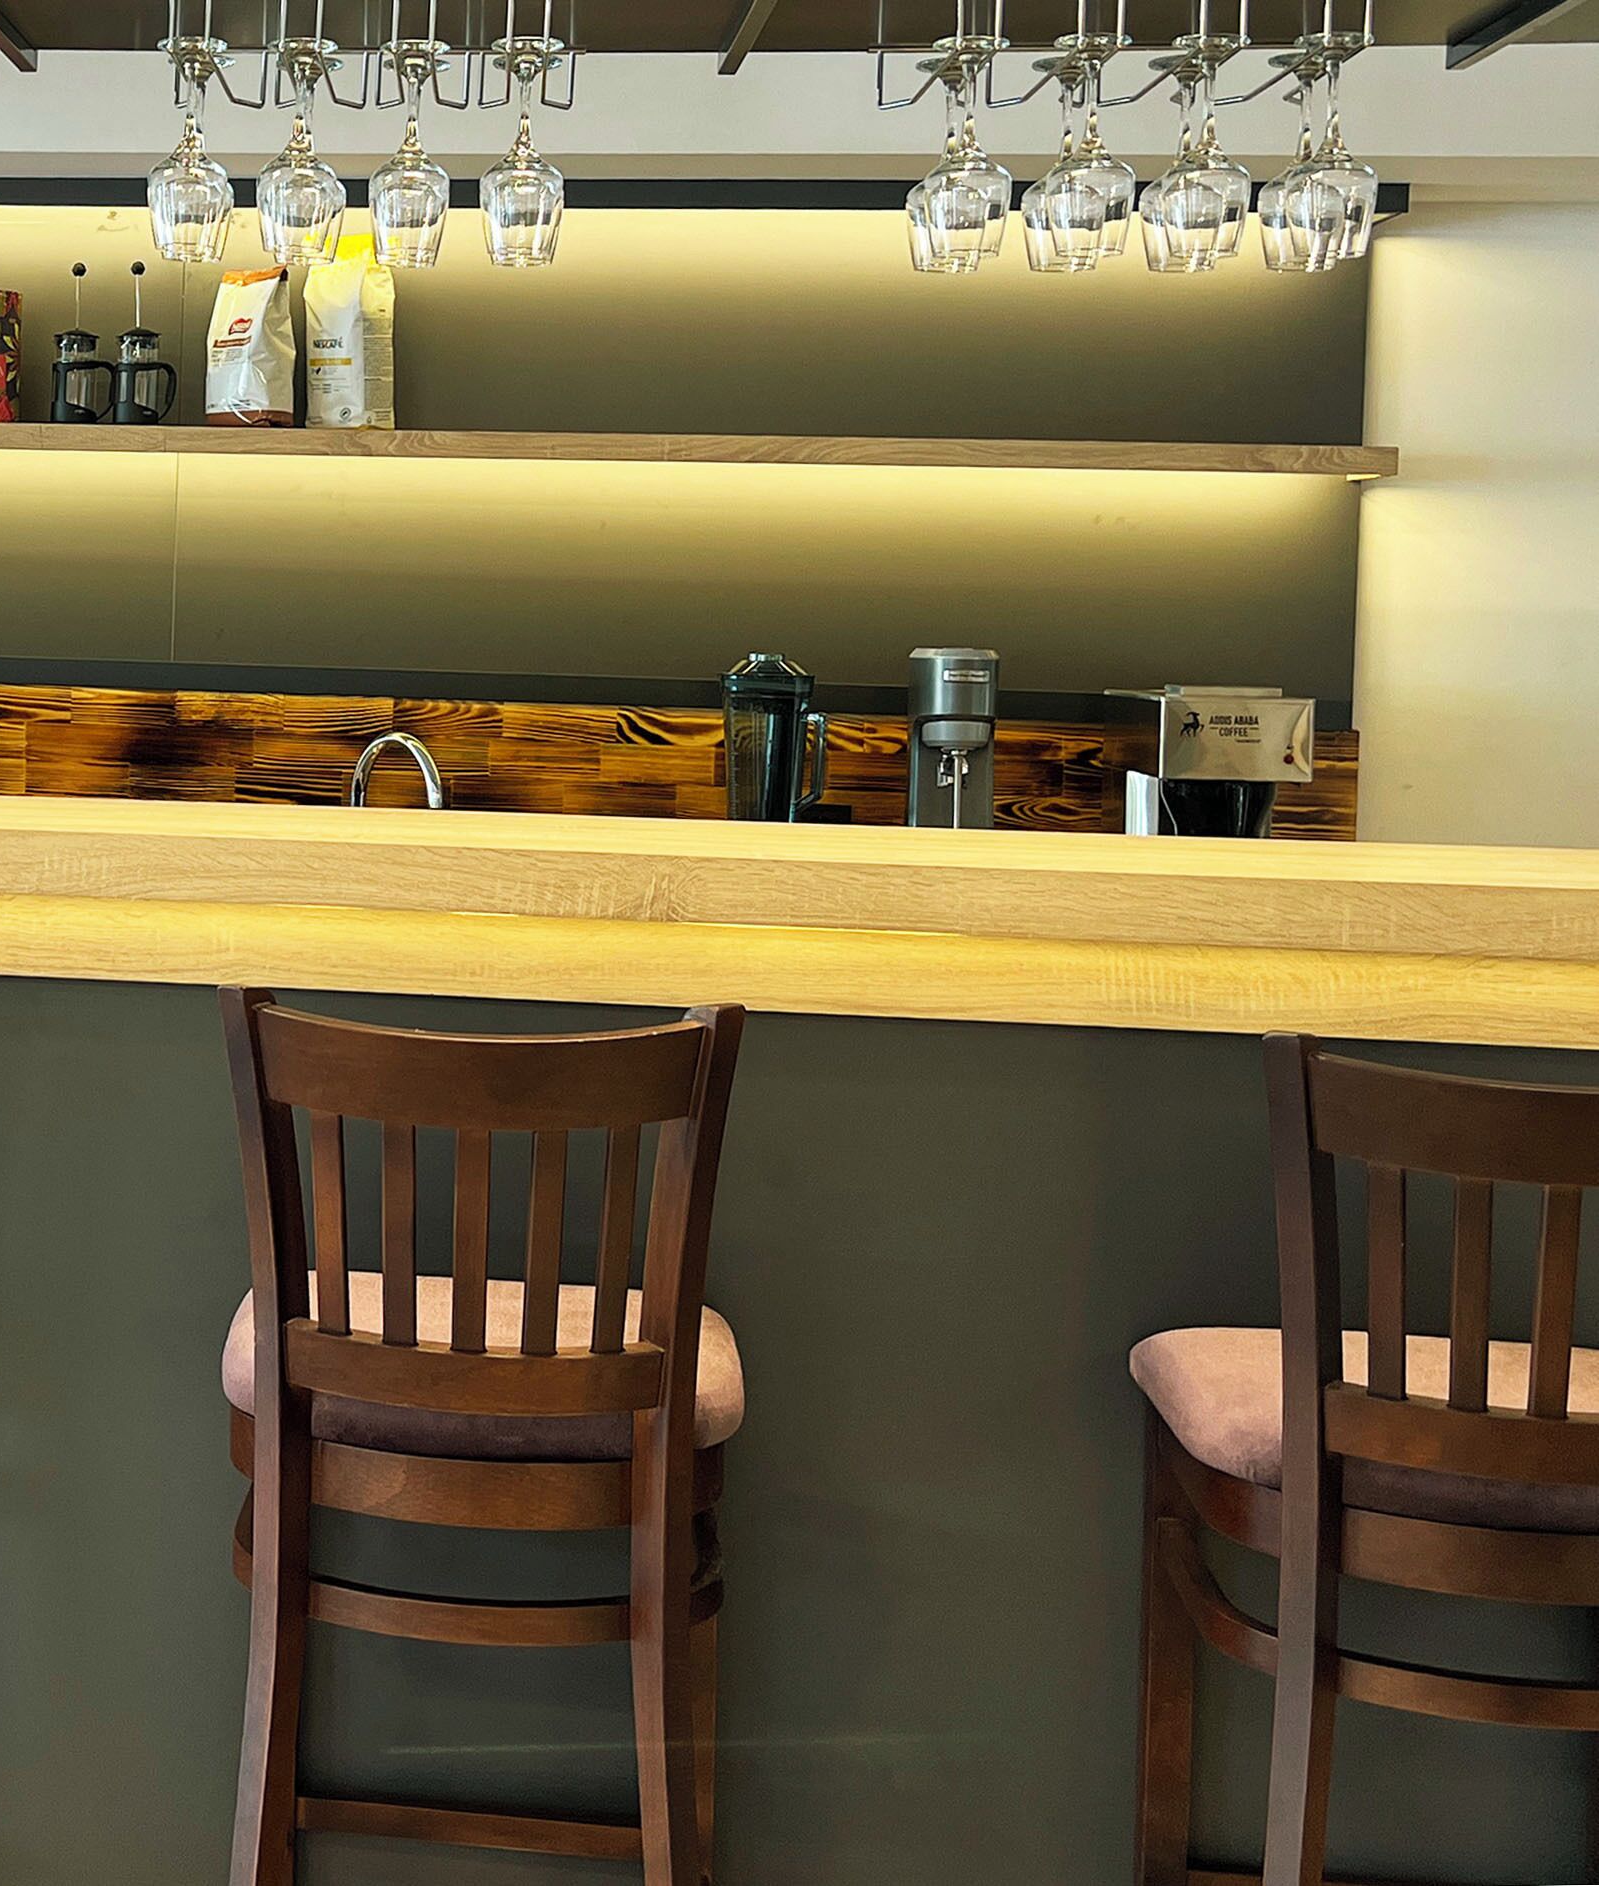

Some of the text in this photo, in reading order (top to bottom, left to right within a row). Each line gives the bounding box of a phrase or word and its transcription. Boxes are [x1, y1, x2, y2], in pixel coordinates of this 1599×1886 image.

[1209, 716, 1259, 726] ADDIS ABABA
[1219, 728, 1248, 737] COFFEE
